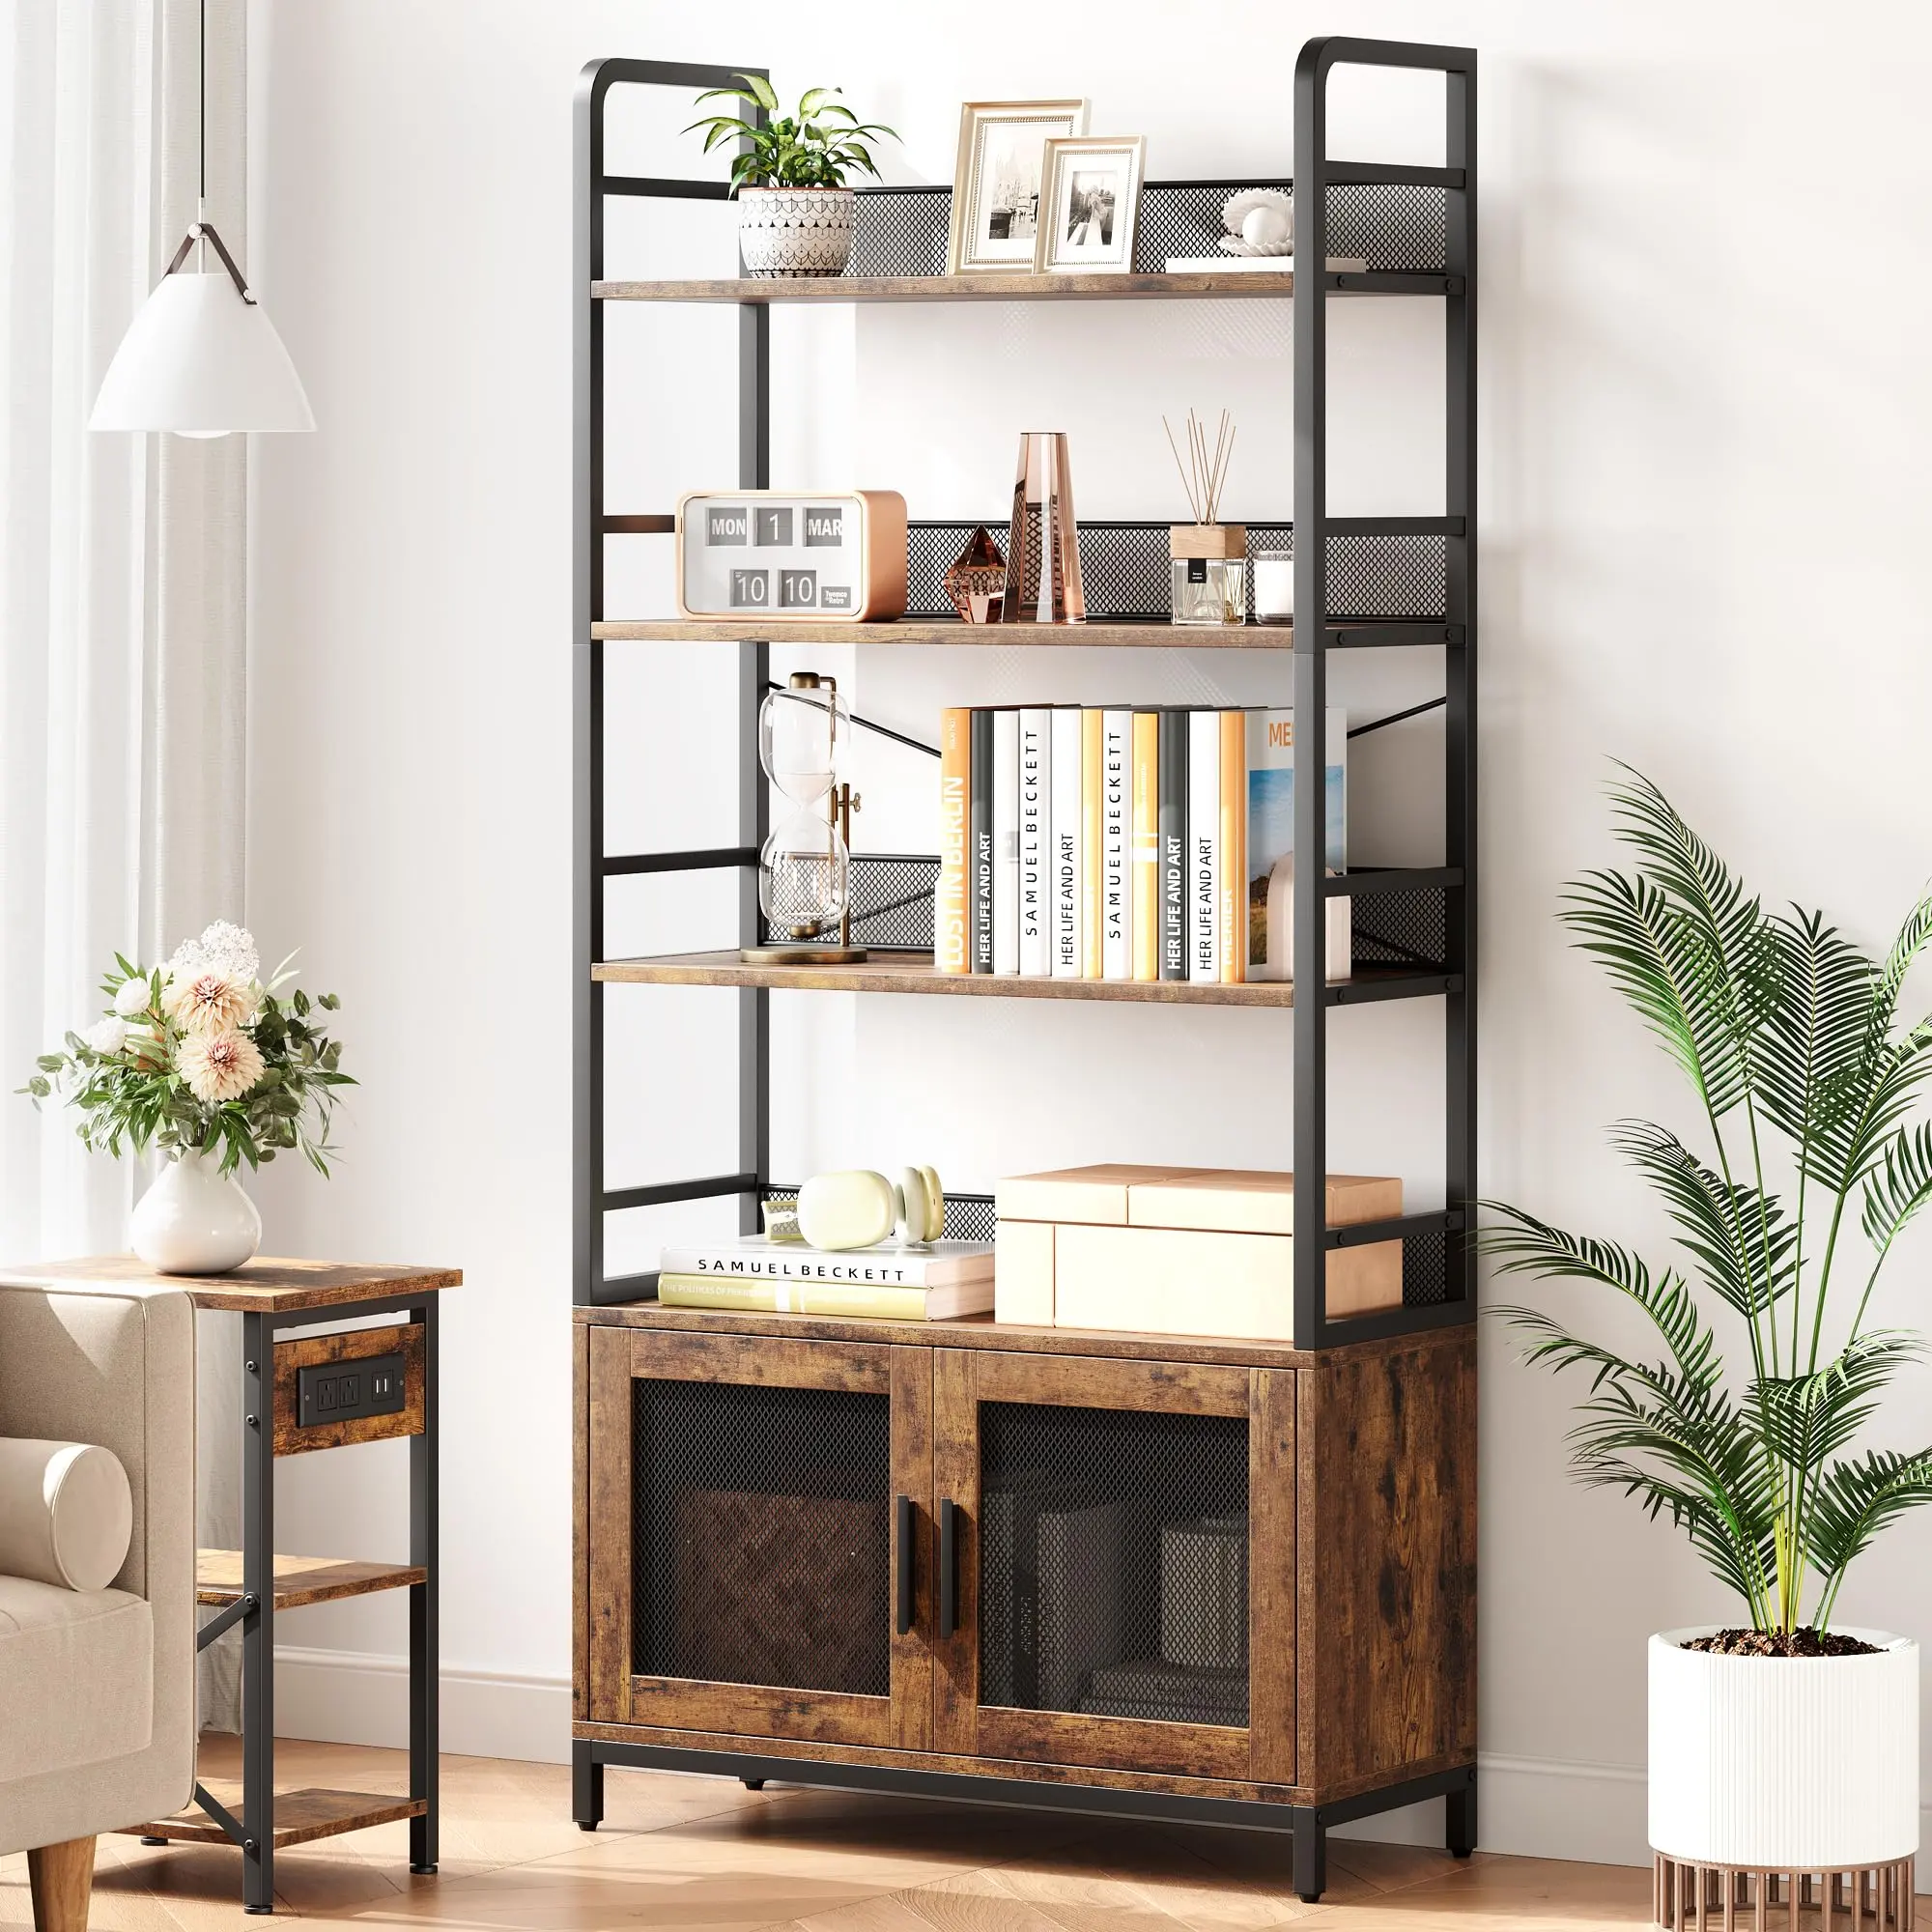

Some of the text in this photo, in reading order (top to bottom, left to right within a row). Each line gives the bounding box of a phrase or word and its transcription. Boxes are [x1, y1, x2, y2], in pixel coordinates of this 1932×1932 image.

[711, 519, 747, 535] MON
[769, 514, 780, 541] 1
[808, 519, 842, 535] MAR
[737, 576, 765, 602] 10
[785, 576, 812, 602] 10
[1268, 723, 1294, 747] ME
[943, 776, 963, 966] LOST IN BERLIN
[1025, 730, 1037, 936] SAMUEL BECKETT
[1108, 732, 1122, 939] SAMUEL BECKETT
[979, 831, 991, 963] HER LIFE AND ART
[1061, 833, 1073, 965] HER LIFE AND ART
[1166, 835, 1181, 970] HER LIFE AND ART
[1199, 837, 1212, 970] HER LIFE AND ART
[697, 1259, 904, 1282] SAMUEL BECKETT
